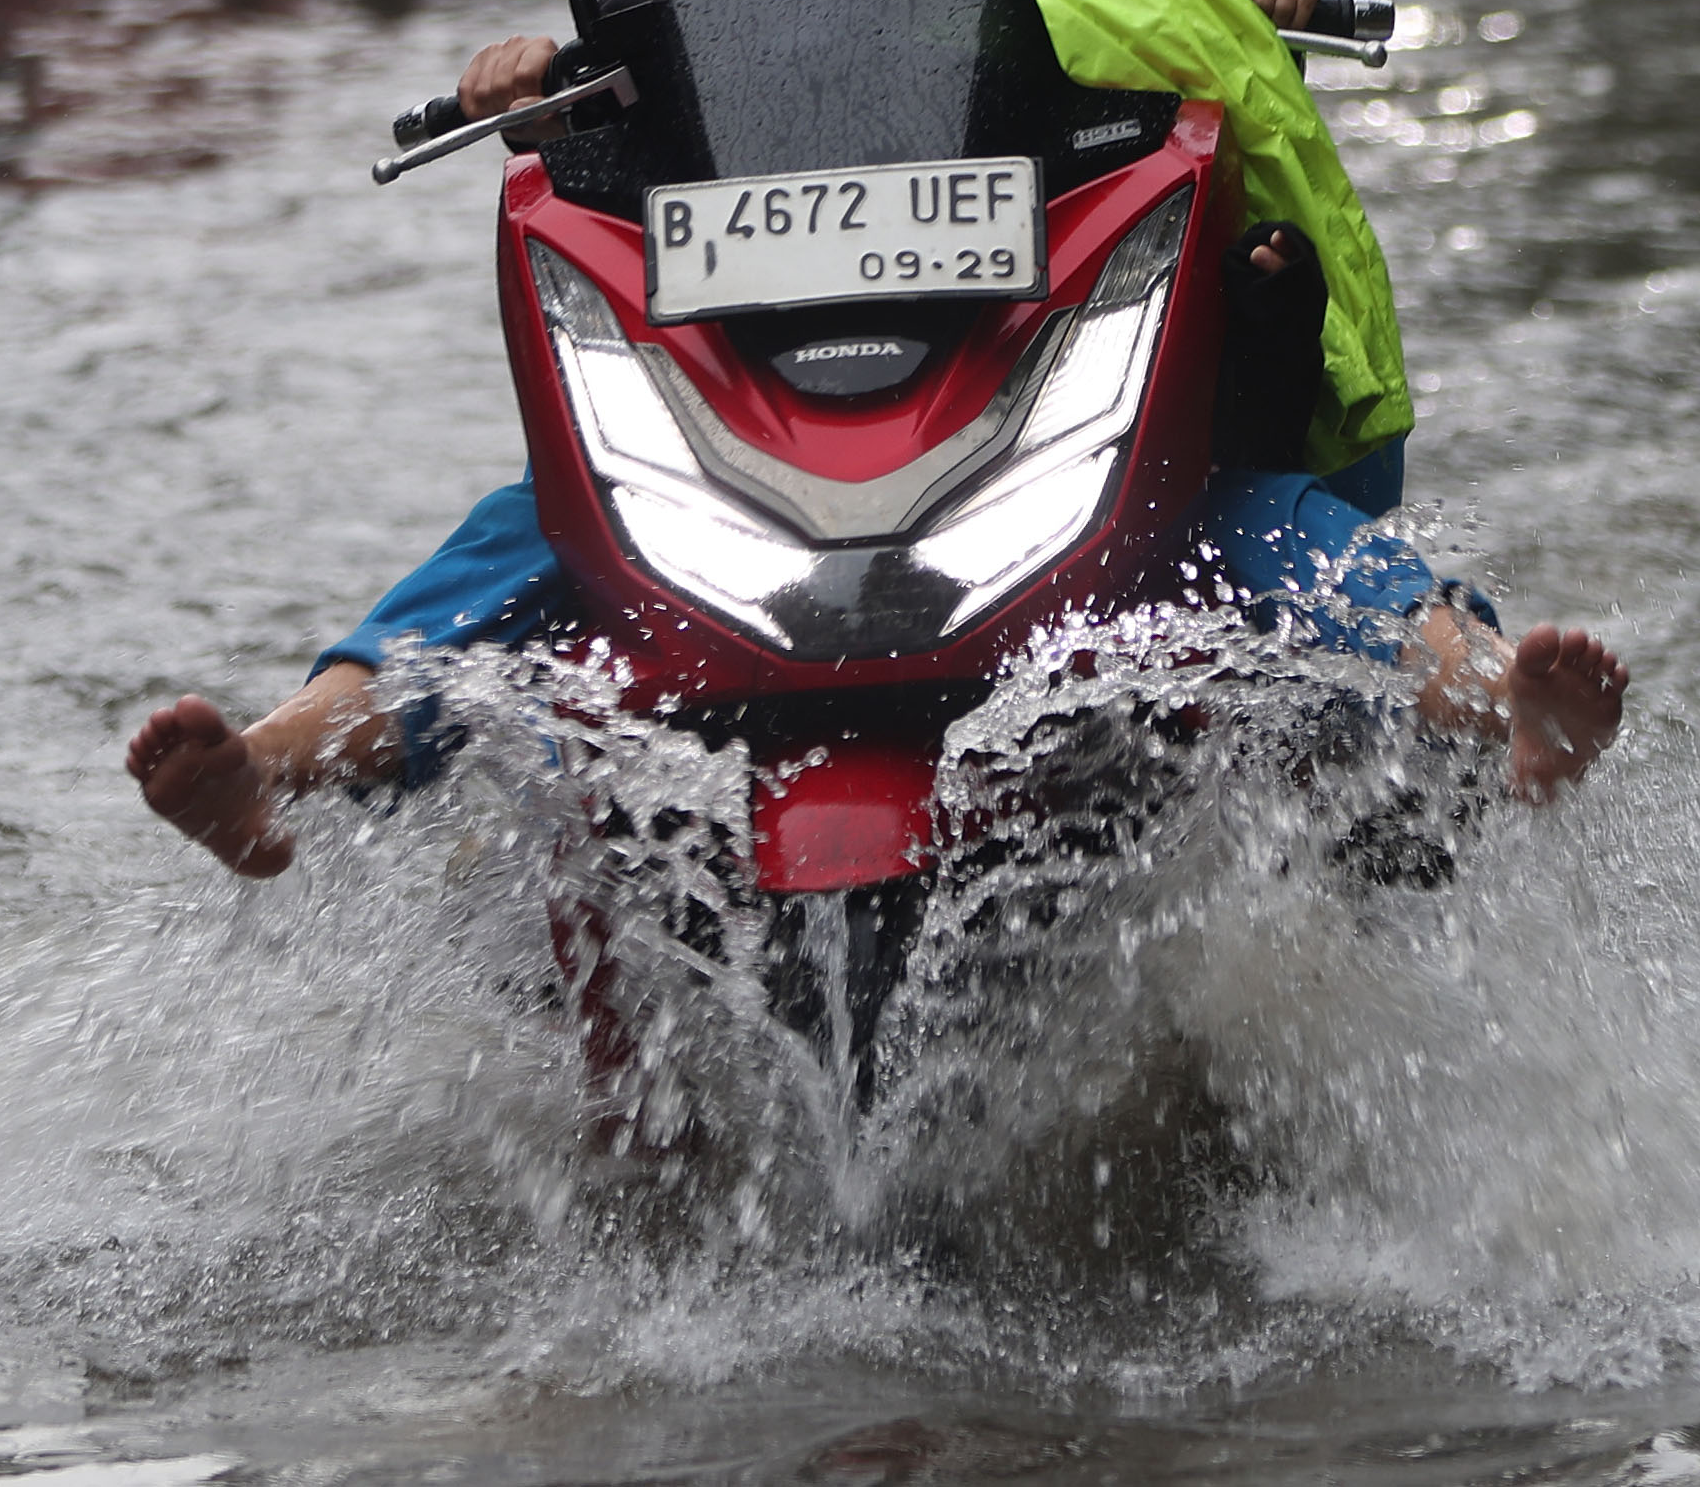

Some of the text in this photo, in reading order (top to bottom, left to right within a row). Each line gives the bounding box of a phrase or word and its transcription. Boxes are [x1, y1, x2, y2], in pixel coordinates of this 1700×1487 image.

[664, 172, 1014, 248] B 4672 UEF
[794, 342, 904, 364] HONDA
